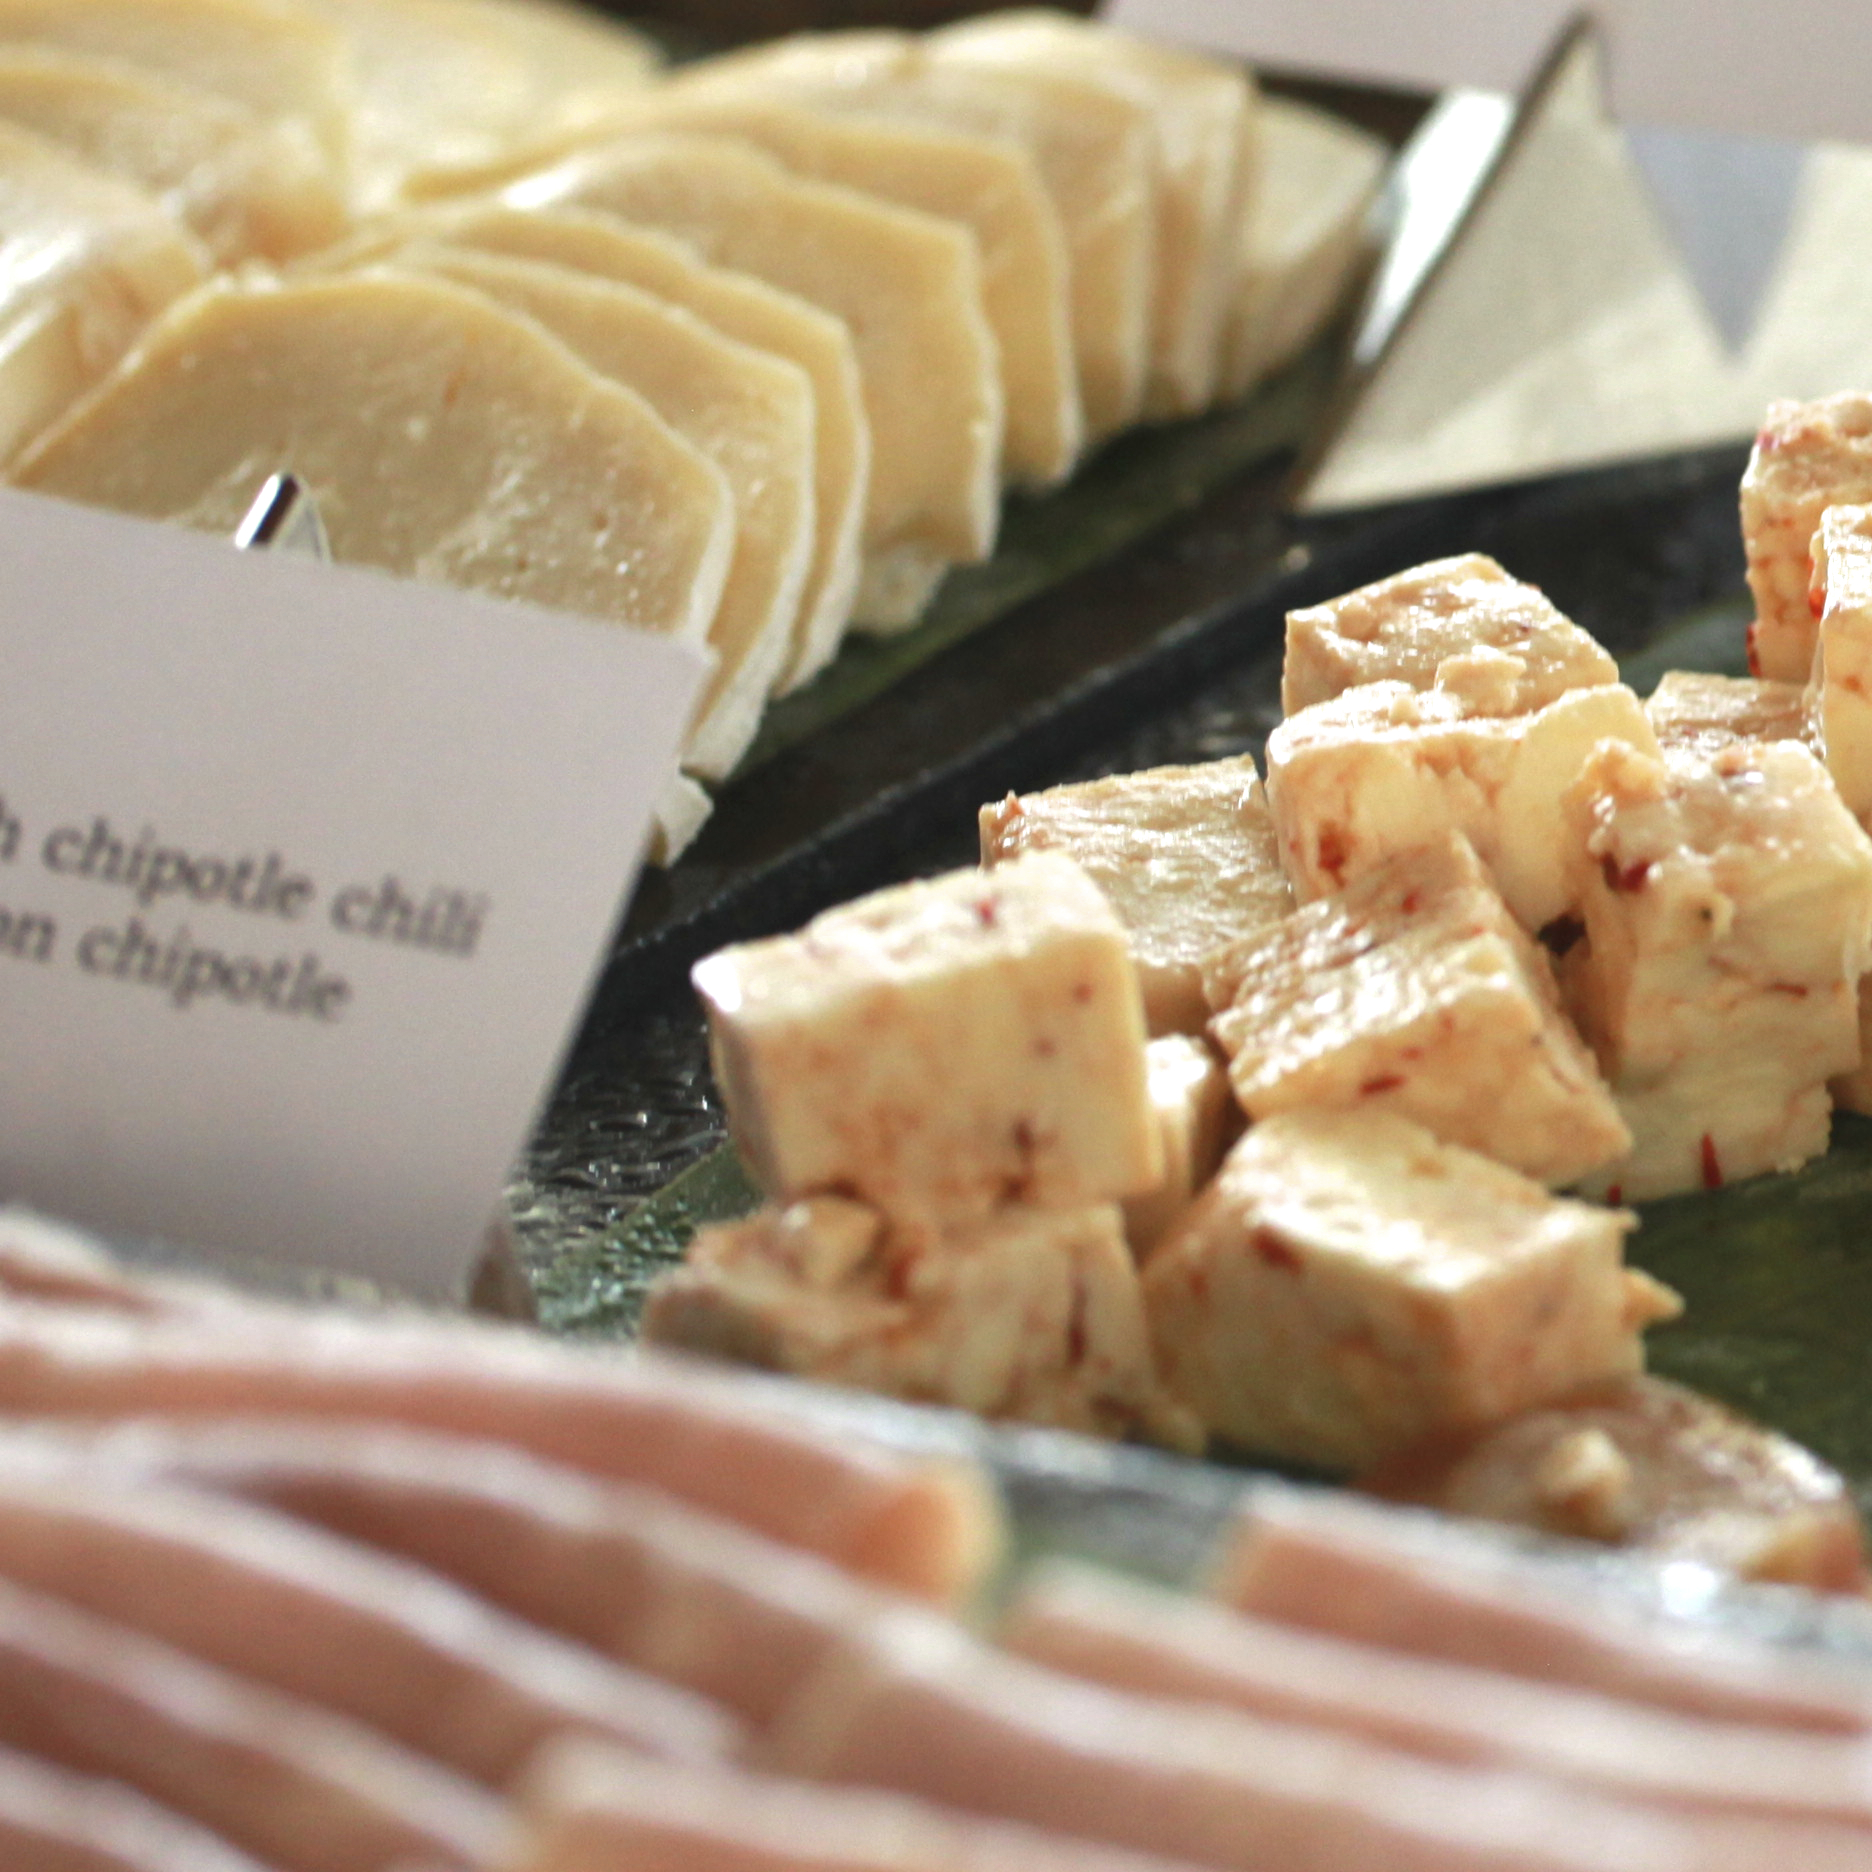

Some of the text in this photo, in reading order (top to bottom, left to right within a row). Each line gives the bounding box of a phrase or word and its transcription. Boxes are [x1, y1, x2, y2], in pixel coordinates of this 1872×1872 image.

[40, 815, 315, 919] chipotle
[328, 874, 489, 959] chili
[75, 916, 351, 1022] chipotle
